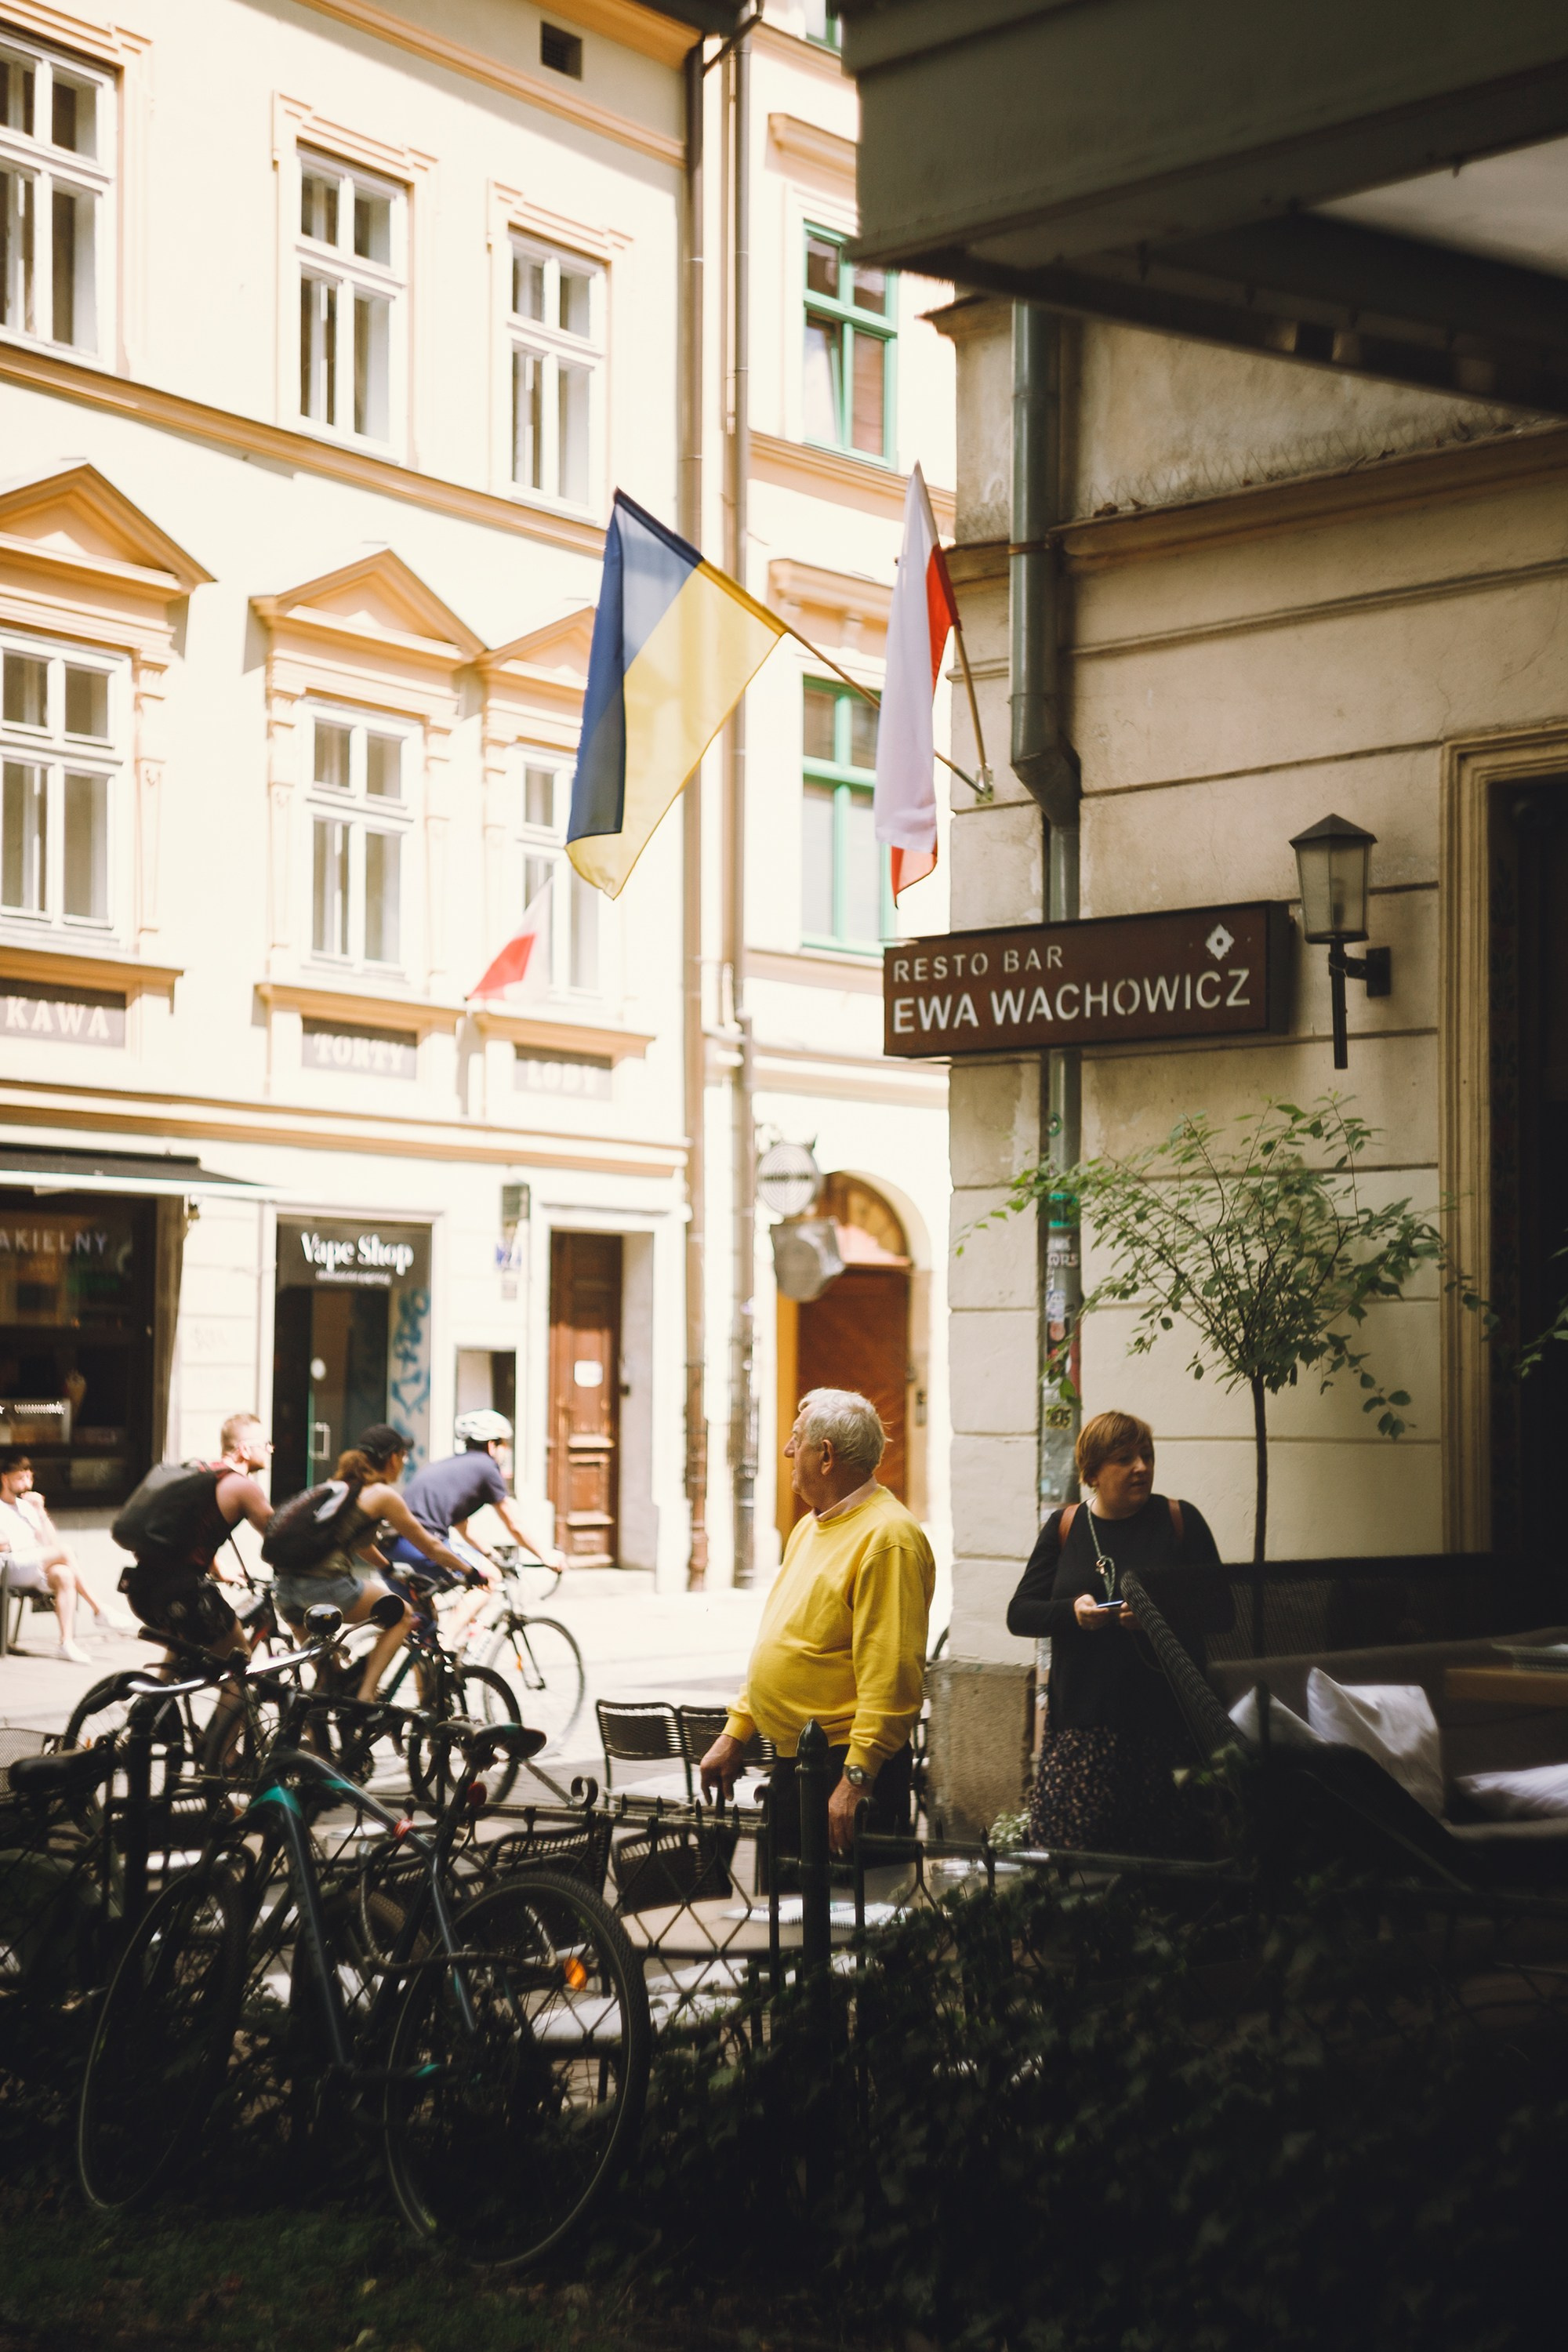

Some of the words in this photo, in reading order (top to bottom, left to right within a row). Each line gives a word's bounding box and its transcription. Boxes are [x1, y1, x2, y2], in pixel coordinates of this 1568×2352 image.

[893, 952, 989, 982] RESTO
[1004, 946, 1063, 973] BAR
[5, 995, 110, 1040] KAWA
[893, 993, 979, 1034] EWA
[990, 968, 1250, 1026] WACHOWICZ
[314, 1033, 405, 1072] TORTY
[301, 1232, 355, 1272] Vape
[358, 1233, 415, 1276] Shop
